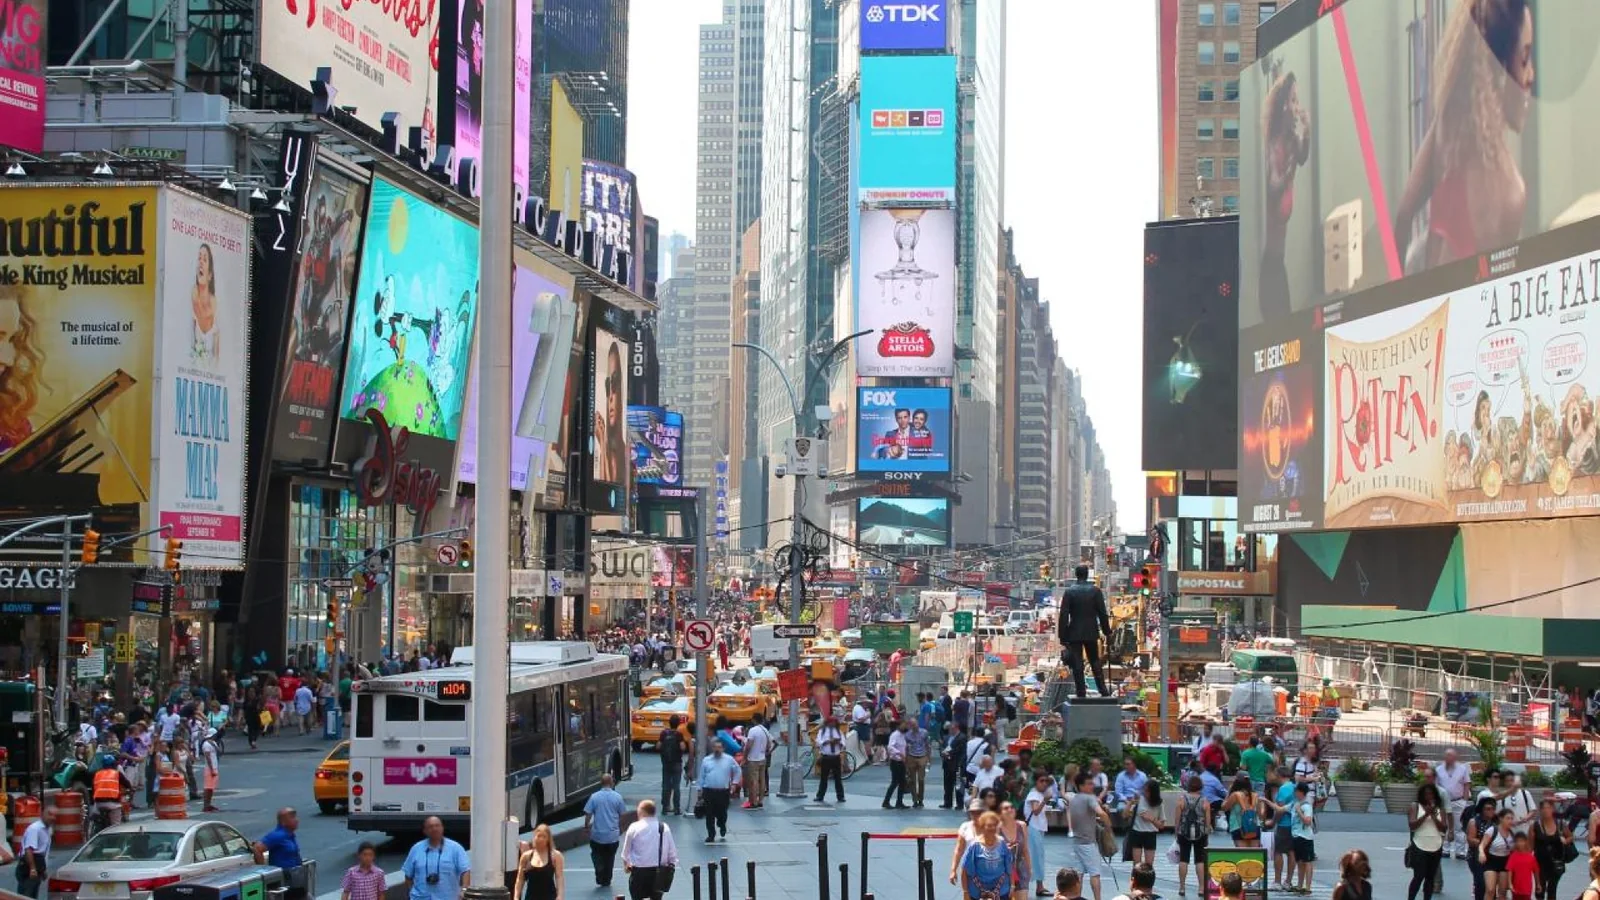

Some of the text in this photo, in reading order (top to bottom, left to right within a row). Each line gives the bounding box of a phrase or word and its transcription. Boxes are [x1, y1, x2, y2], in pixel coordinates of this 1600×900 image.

[0, 0, 41, 44] IG
[884, 5, 940, 22] TDK
[909, 190, 944, 199] DONUTS
[514, 182, 633, 287] ROADWAY
[0, 263, 145, 291] le King Musical
[1509, 271, 1553, 322] BIG,
[61, 321, 134, 332] The musical of
[72, 334, 121, 346] a lifetime.
[888, 335, 925, 344] STELLA
[888, 344, 925, 352] ARTOIS
[1341, 326, 1430, 372] SOMETHING
[633, 329, 645, 377] 1500
[175, 376, 230, 443] MAMMA
[863, 391, 897, 407] FOX
[1330, 328, 1444, 490] ROTTEN!
[352, 407, 441, 544] Disney
[884, 472, 923, 480] SONY
[0, 567, 76, 589] GAGE
[118, 635, 127, 658] ATM
